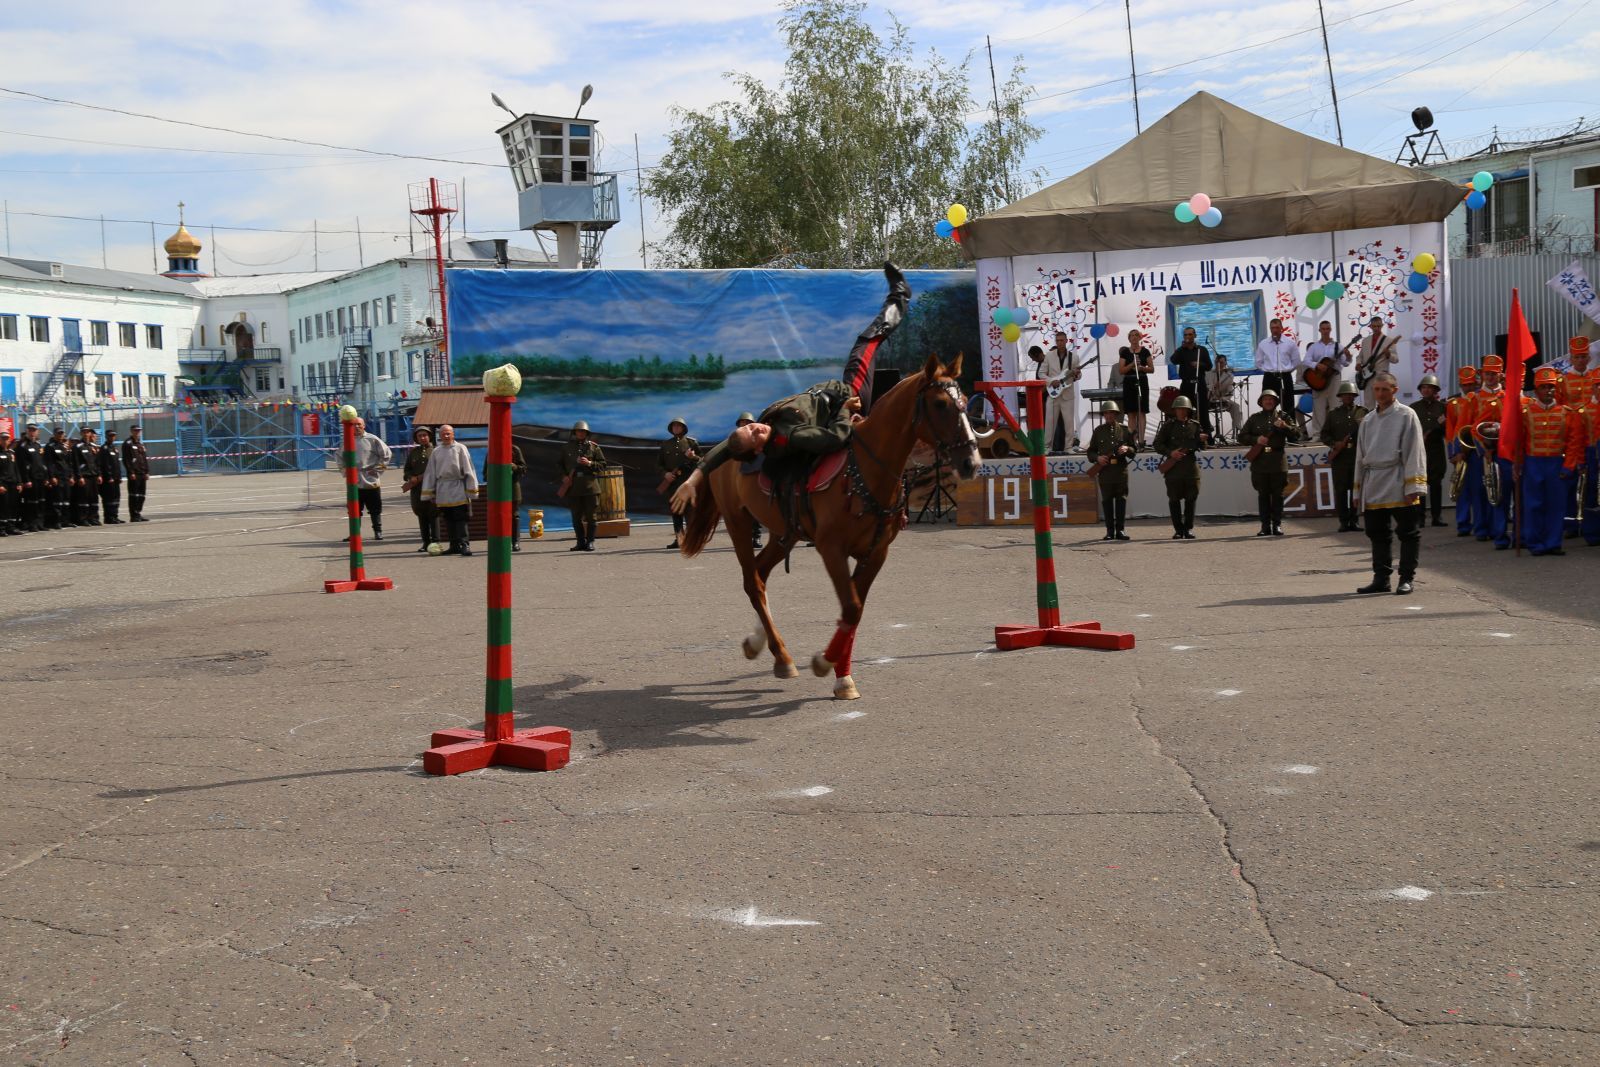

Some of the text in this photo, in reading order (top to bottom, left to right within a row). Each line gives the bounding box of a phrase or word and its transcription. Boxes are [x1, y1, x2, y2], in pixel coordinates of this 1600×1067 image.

[1056, 259, 1365, 309] СТАНИЦА ШОЛОХОВСКАЯ
[988, 476, 1068, 520] 195
